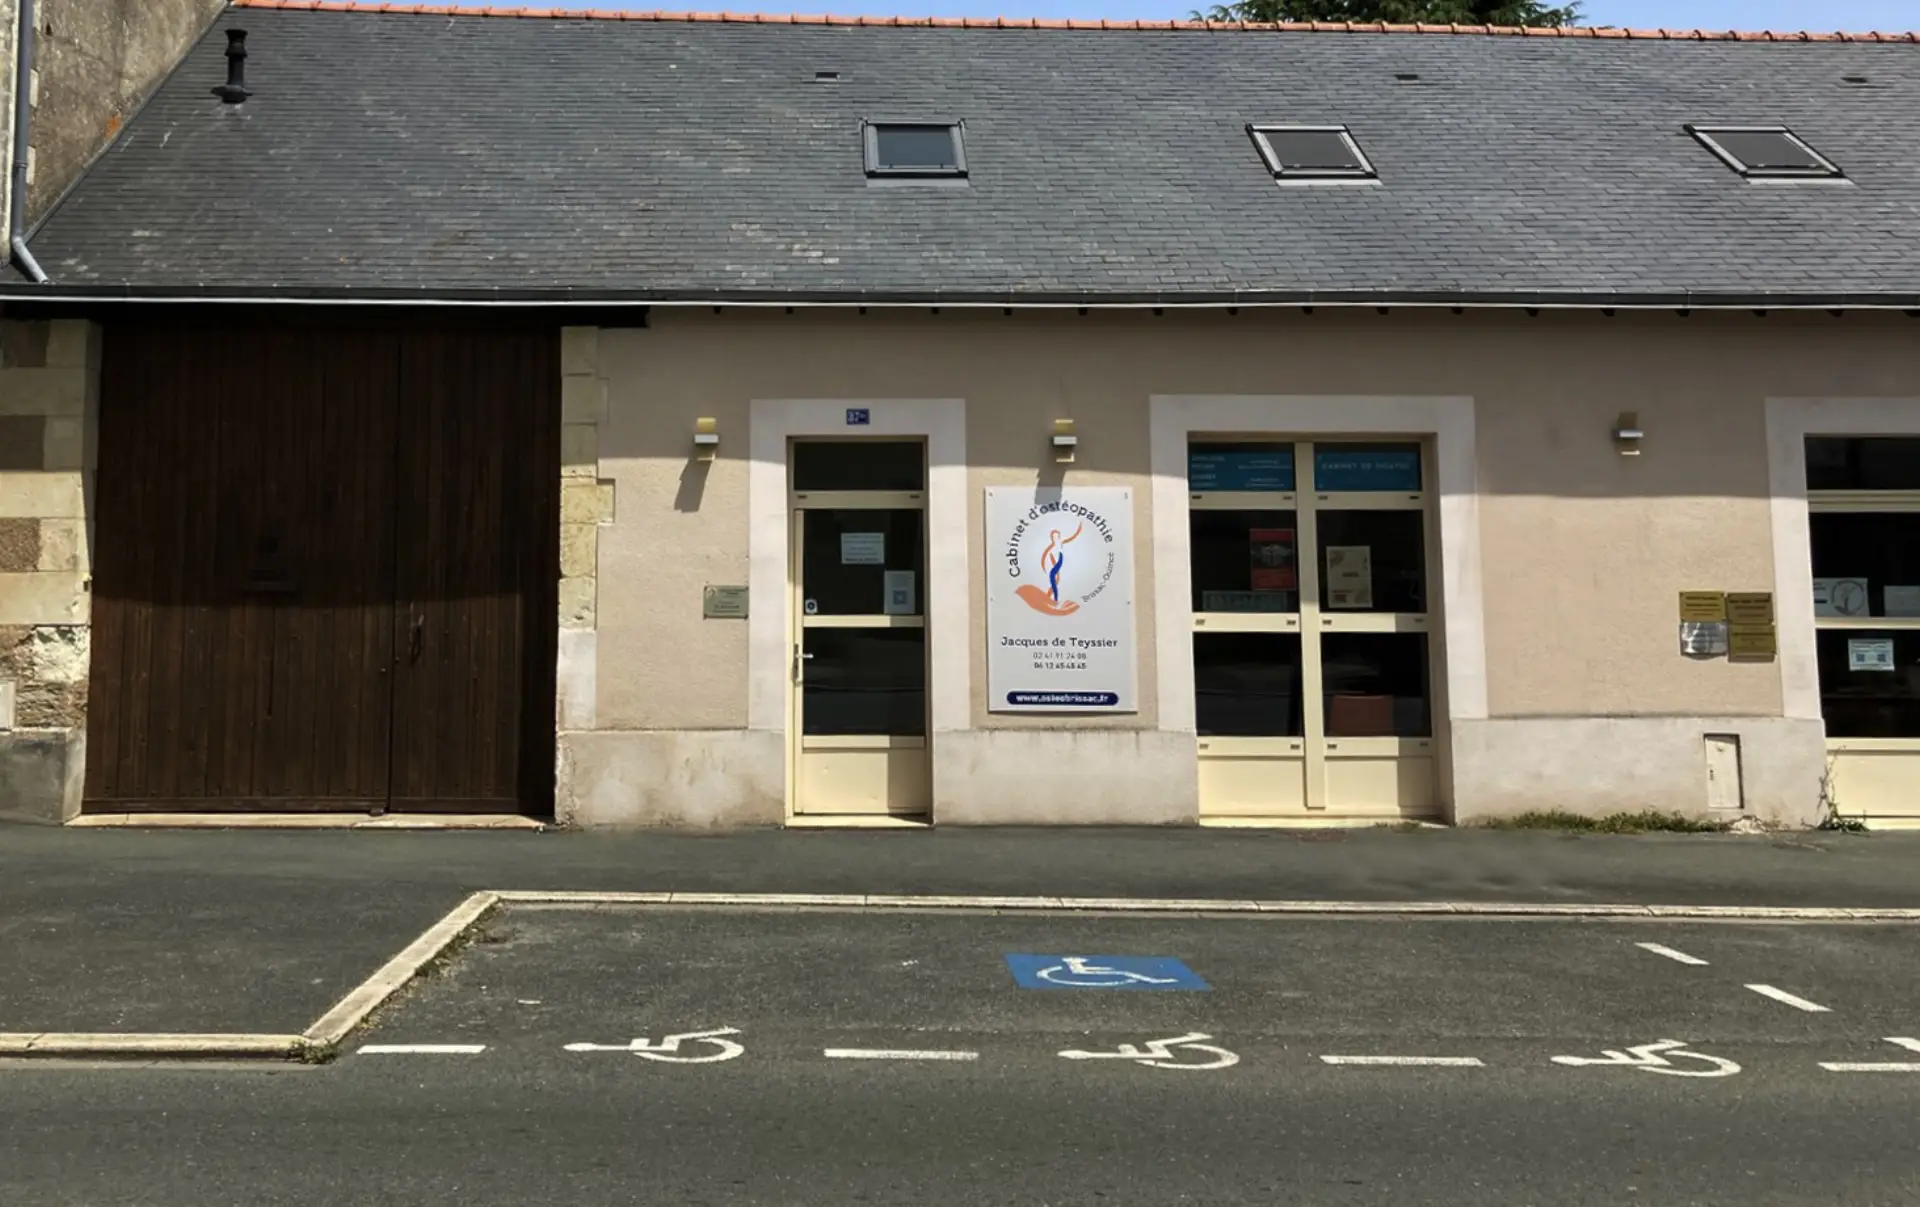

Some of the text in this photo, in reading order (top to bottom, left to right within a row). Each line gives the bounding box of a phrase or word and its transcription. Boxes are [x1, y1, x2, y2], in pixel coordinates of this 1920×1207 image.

[1005, 500, 1114, 578] Cabinet d'ostéopathie
[1001, 636, 1118, 649] Jacques de Teyssier
